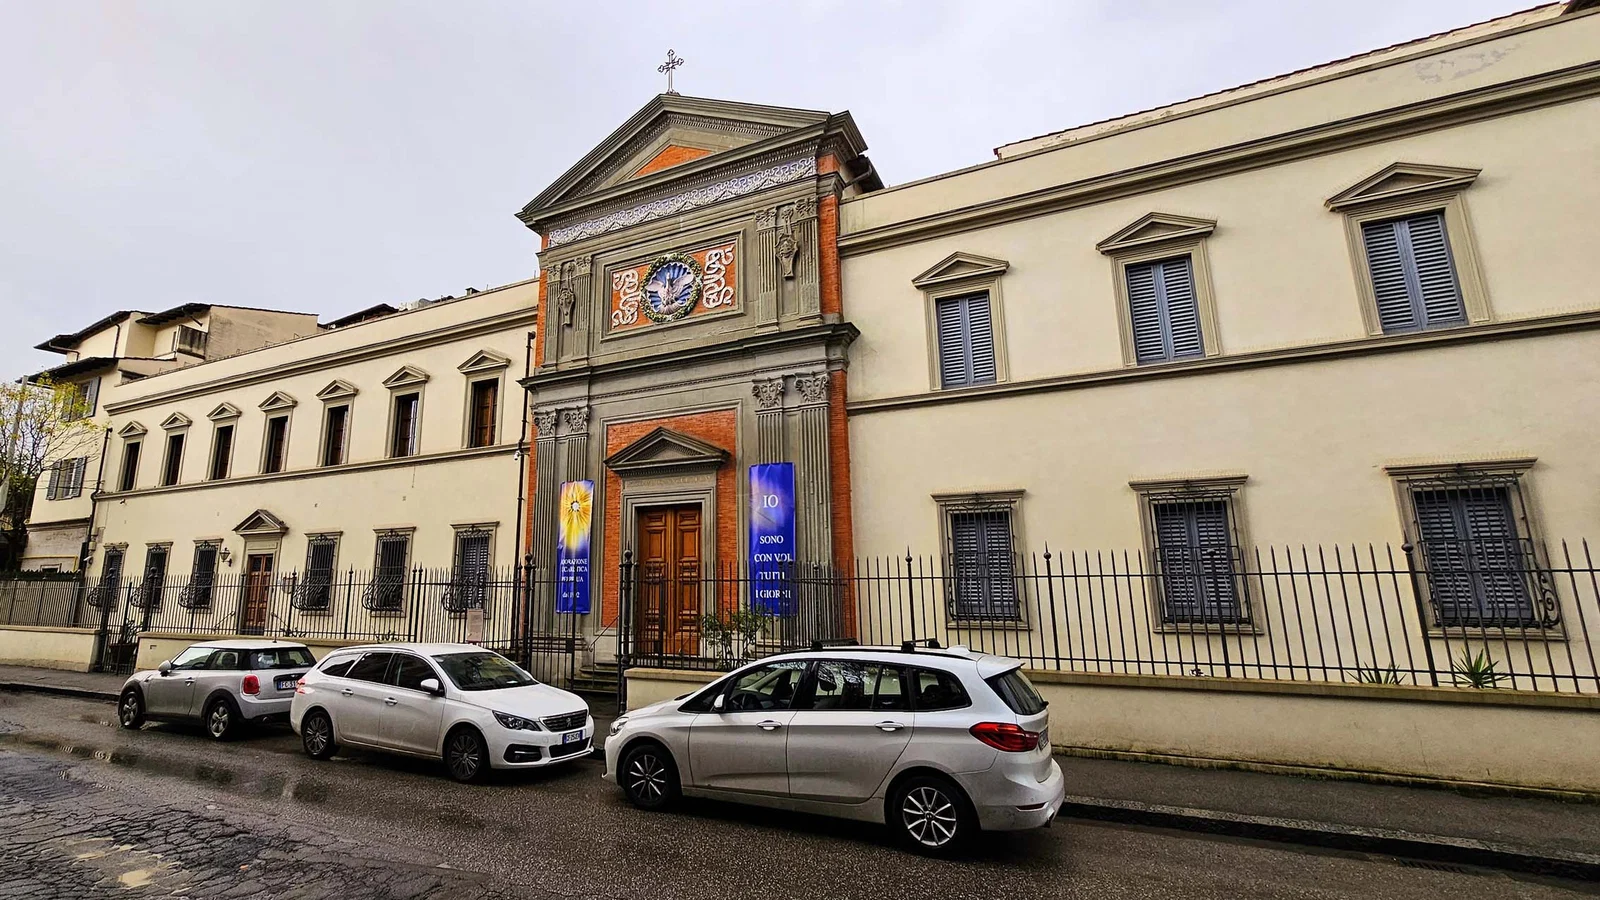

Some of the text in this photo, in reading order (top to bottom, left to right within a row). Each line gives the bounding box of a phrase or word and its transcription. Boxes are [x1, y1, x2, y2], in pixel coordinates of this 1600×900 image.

[763, 494, 779, 508] IO
[759, 535, 784, 544] SONO
[754, 553, 773, 562] CON
